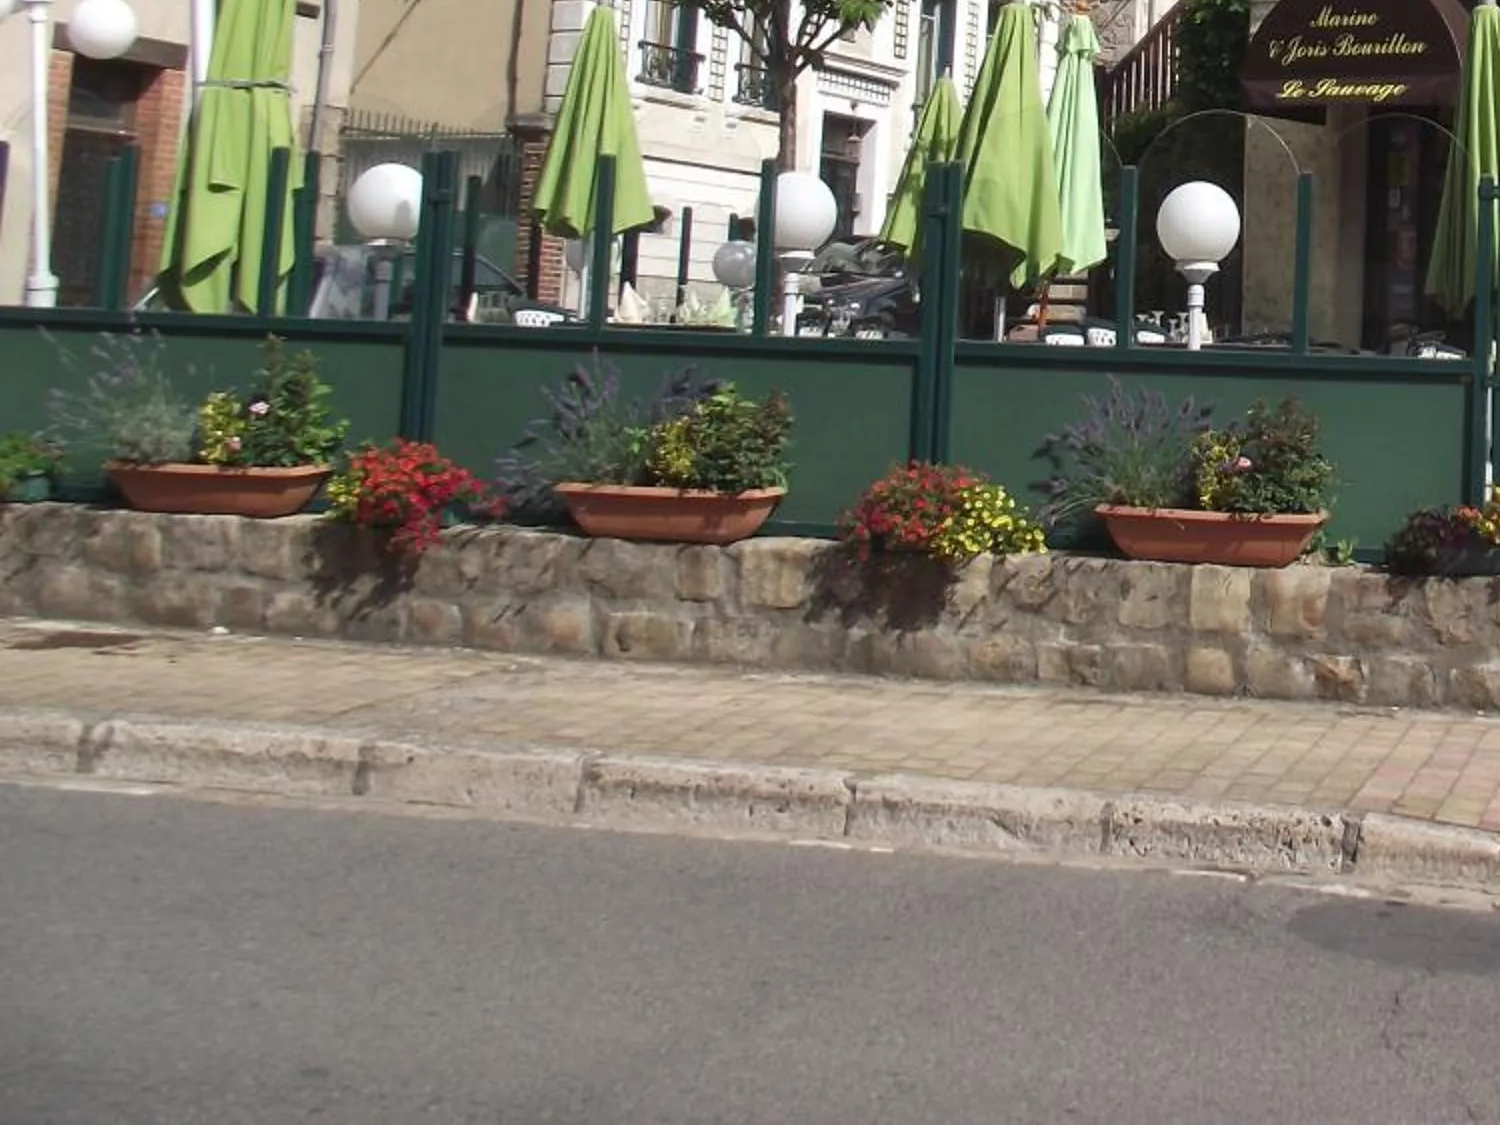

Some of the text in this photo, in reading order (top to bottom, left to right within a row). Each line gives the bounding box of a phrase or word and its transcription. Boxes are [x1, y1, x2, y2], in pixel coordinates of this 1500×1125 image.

[1310, 4, 1381, 28] Marine
[1281, 35, 1328, 66] Joris
[1332, 32, 1428, 56] Bourillon
[1275, 78, 1410, 103] Le Sauvage
